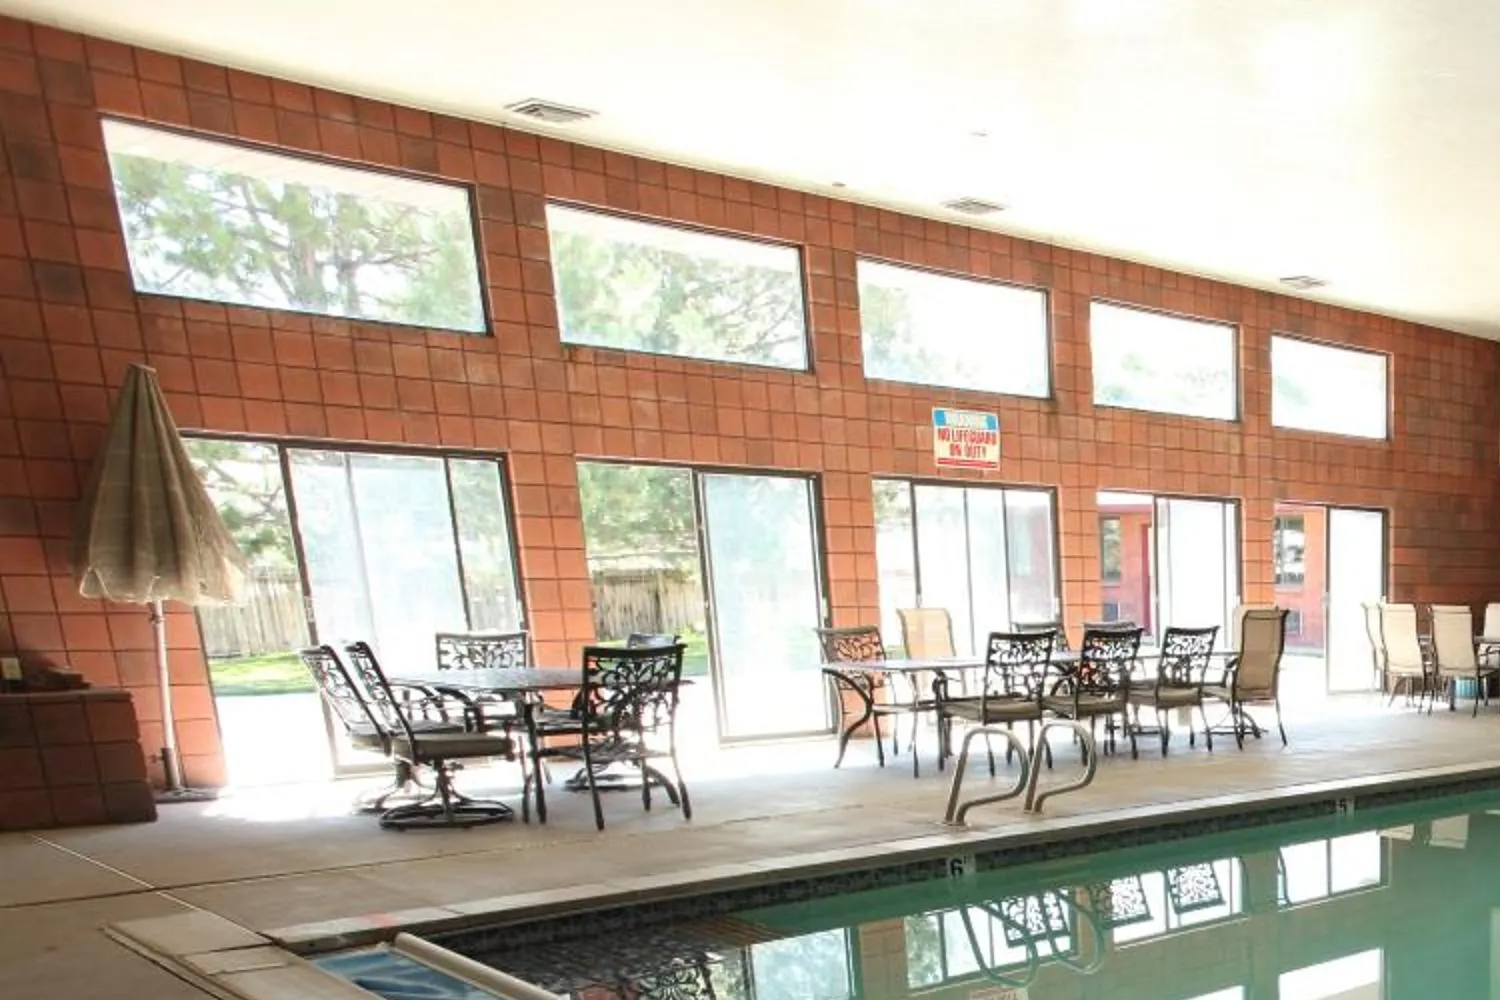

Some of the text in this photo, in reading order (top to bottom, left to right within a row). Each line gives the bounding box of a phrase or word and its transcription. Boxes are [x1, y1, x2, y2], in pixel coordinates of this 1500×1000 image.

[937, 428, 997, 445] NO LIFEGUARD
[950, 443, 986, 458] ON DUTY
